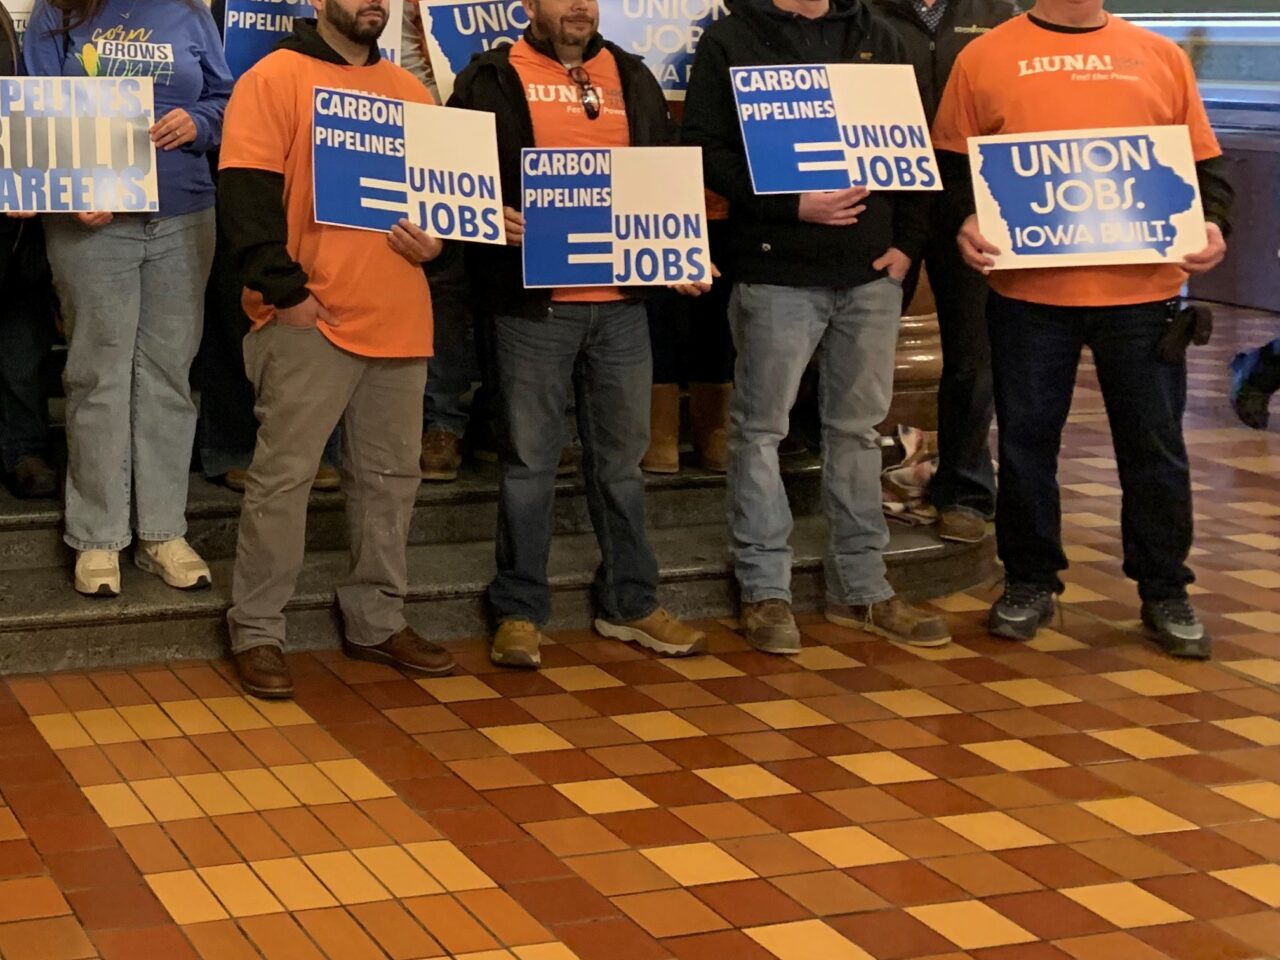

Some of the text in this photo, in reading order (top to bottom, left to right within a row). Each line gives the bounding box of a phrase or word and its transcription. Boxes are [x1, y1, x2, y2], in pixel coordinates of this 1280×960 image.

[102, 41, 169, 60] GROWS
[1018, 54, 1114, 77] LiUNA!
[735, 68, 828, 92] CARBON
[315, 92, 404, 127] CARBON
[740, 100, 835, 121] PIPELINES
[315, 126, 405, 158] PIPELINES
[842, 124, 927, 149] UNION
[524, 152, 610, 176] CARBON
[852, 156, 936, 187] JOBS
[1011, 139, 1151, 177] UNION
[409, 167, 496, 200] UNION
[525, 188, 611, 208] PIPELINES
[417, 201, 500, 241] JOBS
[614, 213, 701, 240] UNION
[1016, 220, 1171, 248] IOWA BUILT.
[615, 247, 705, 283] JOBS
